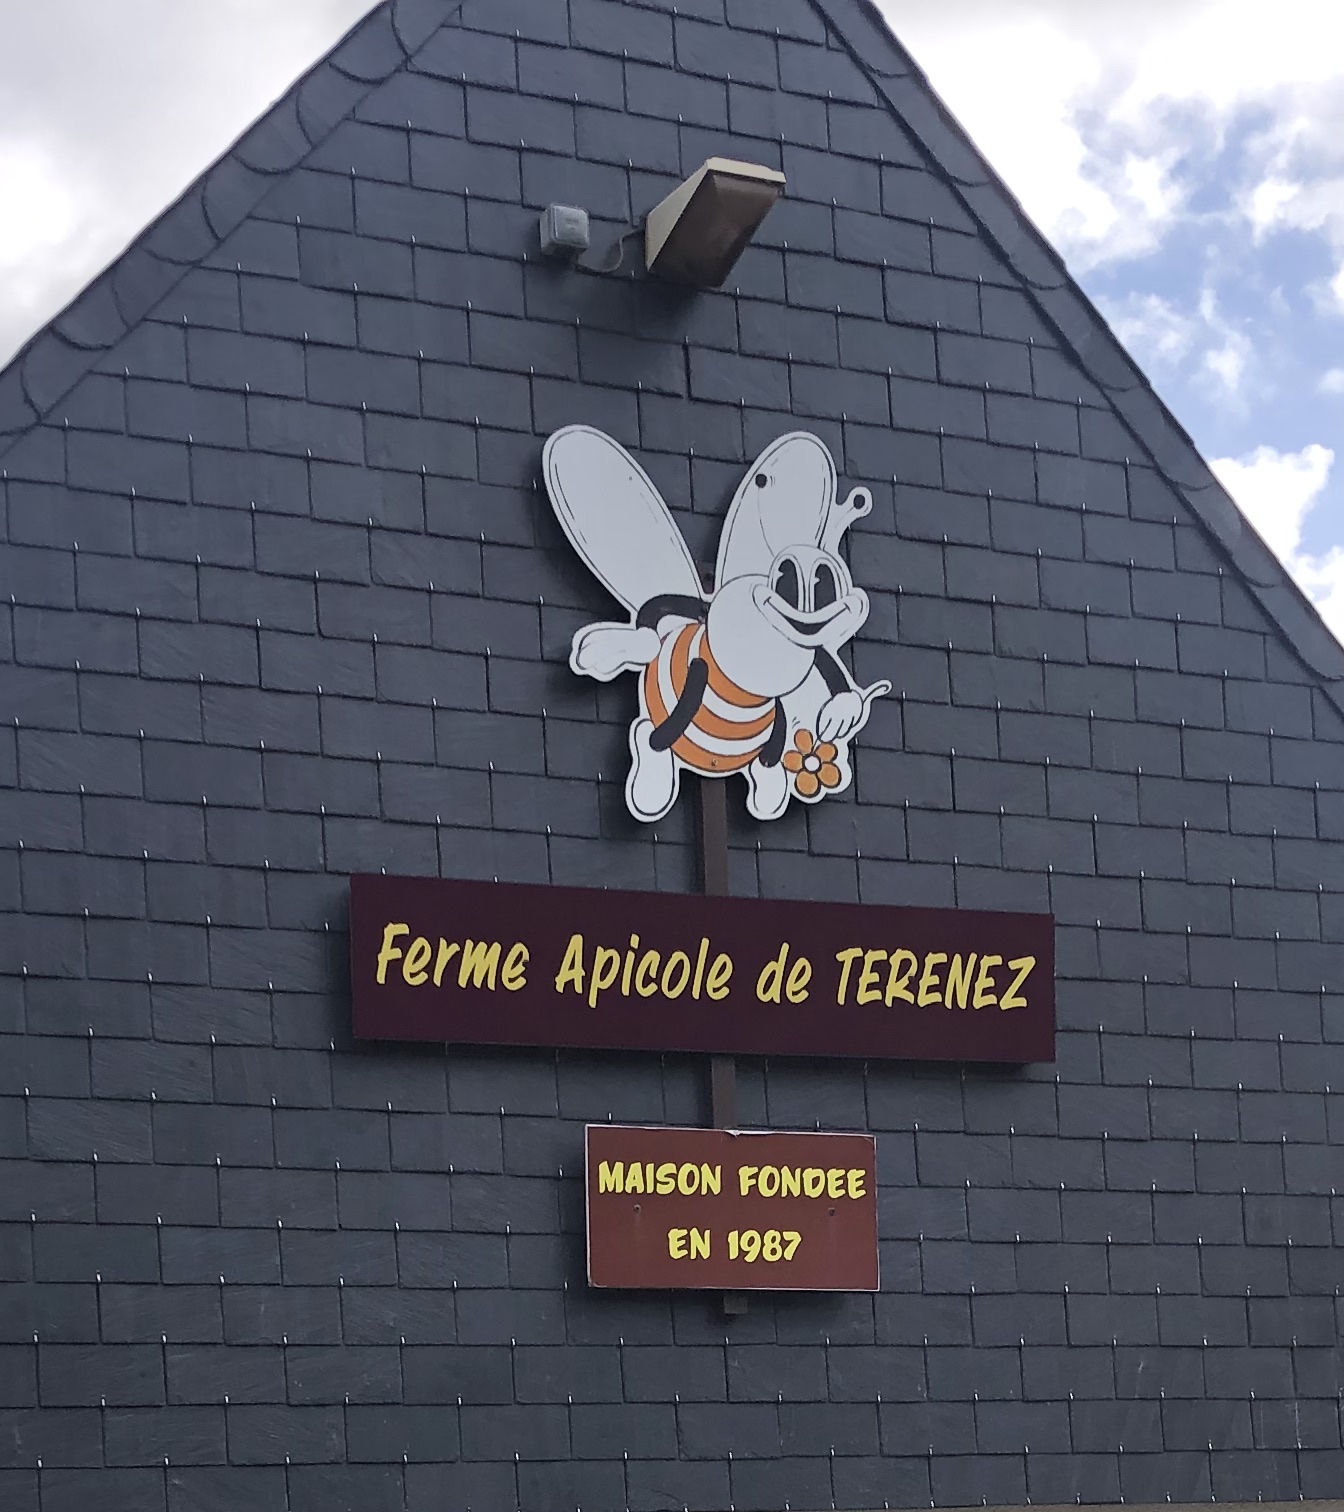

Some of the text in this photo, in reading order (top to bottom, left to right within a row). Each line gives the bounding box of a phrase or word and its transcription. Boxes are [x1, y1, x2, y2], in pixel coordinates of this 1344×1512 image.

[375, 922, 1037, 1010] Ferme Apicole de TERENEZ
[598, 1161, 866, 1200] MAISON FONDEE
[667, 1227, 803, 1263] EN 1987
